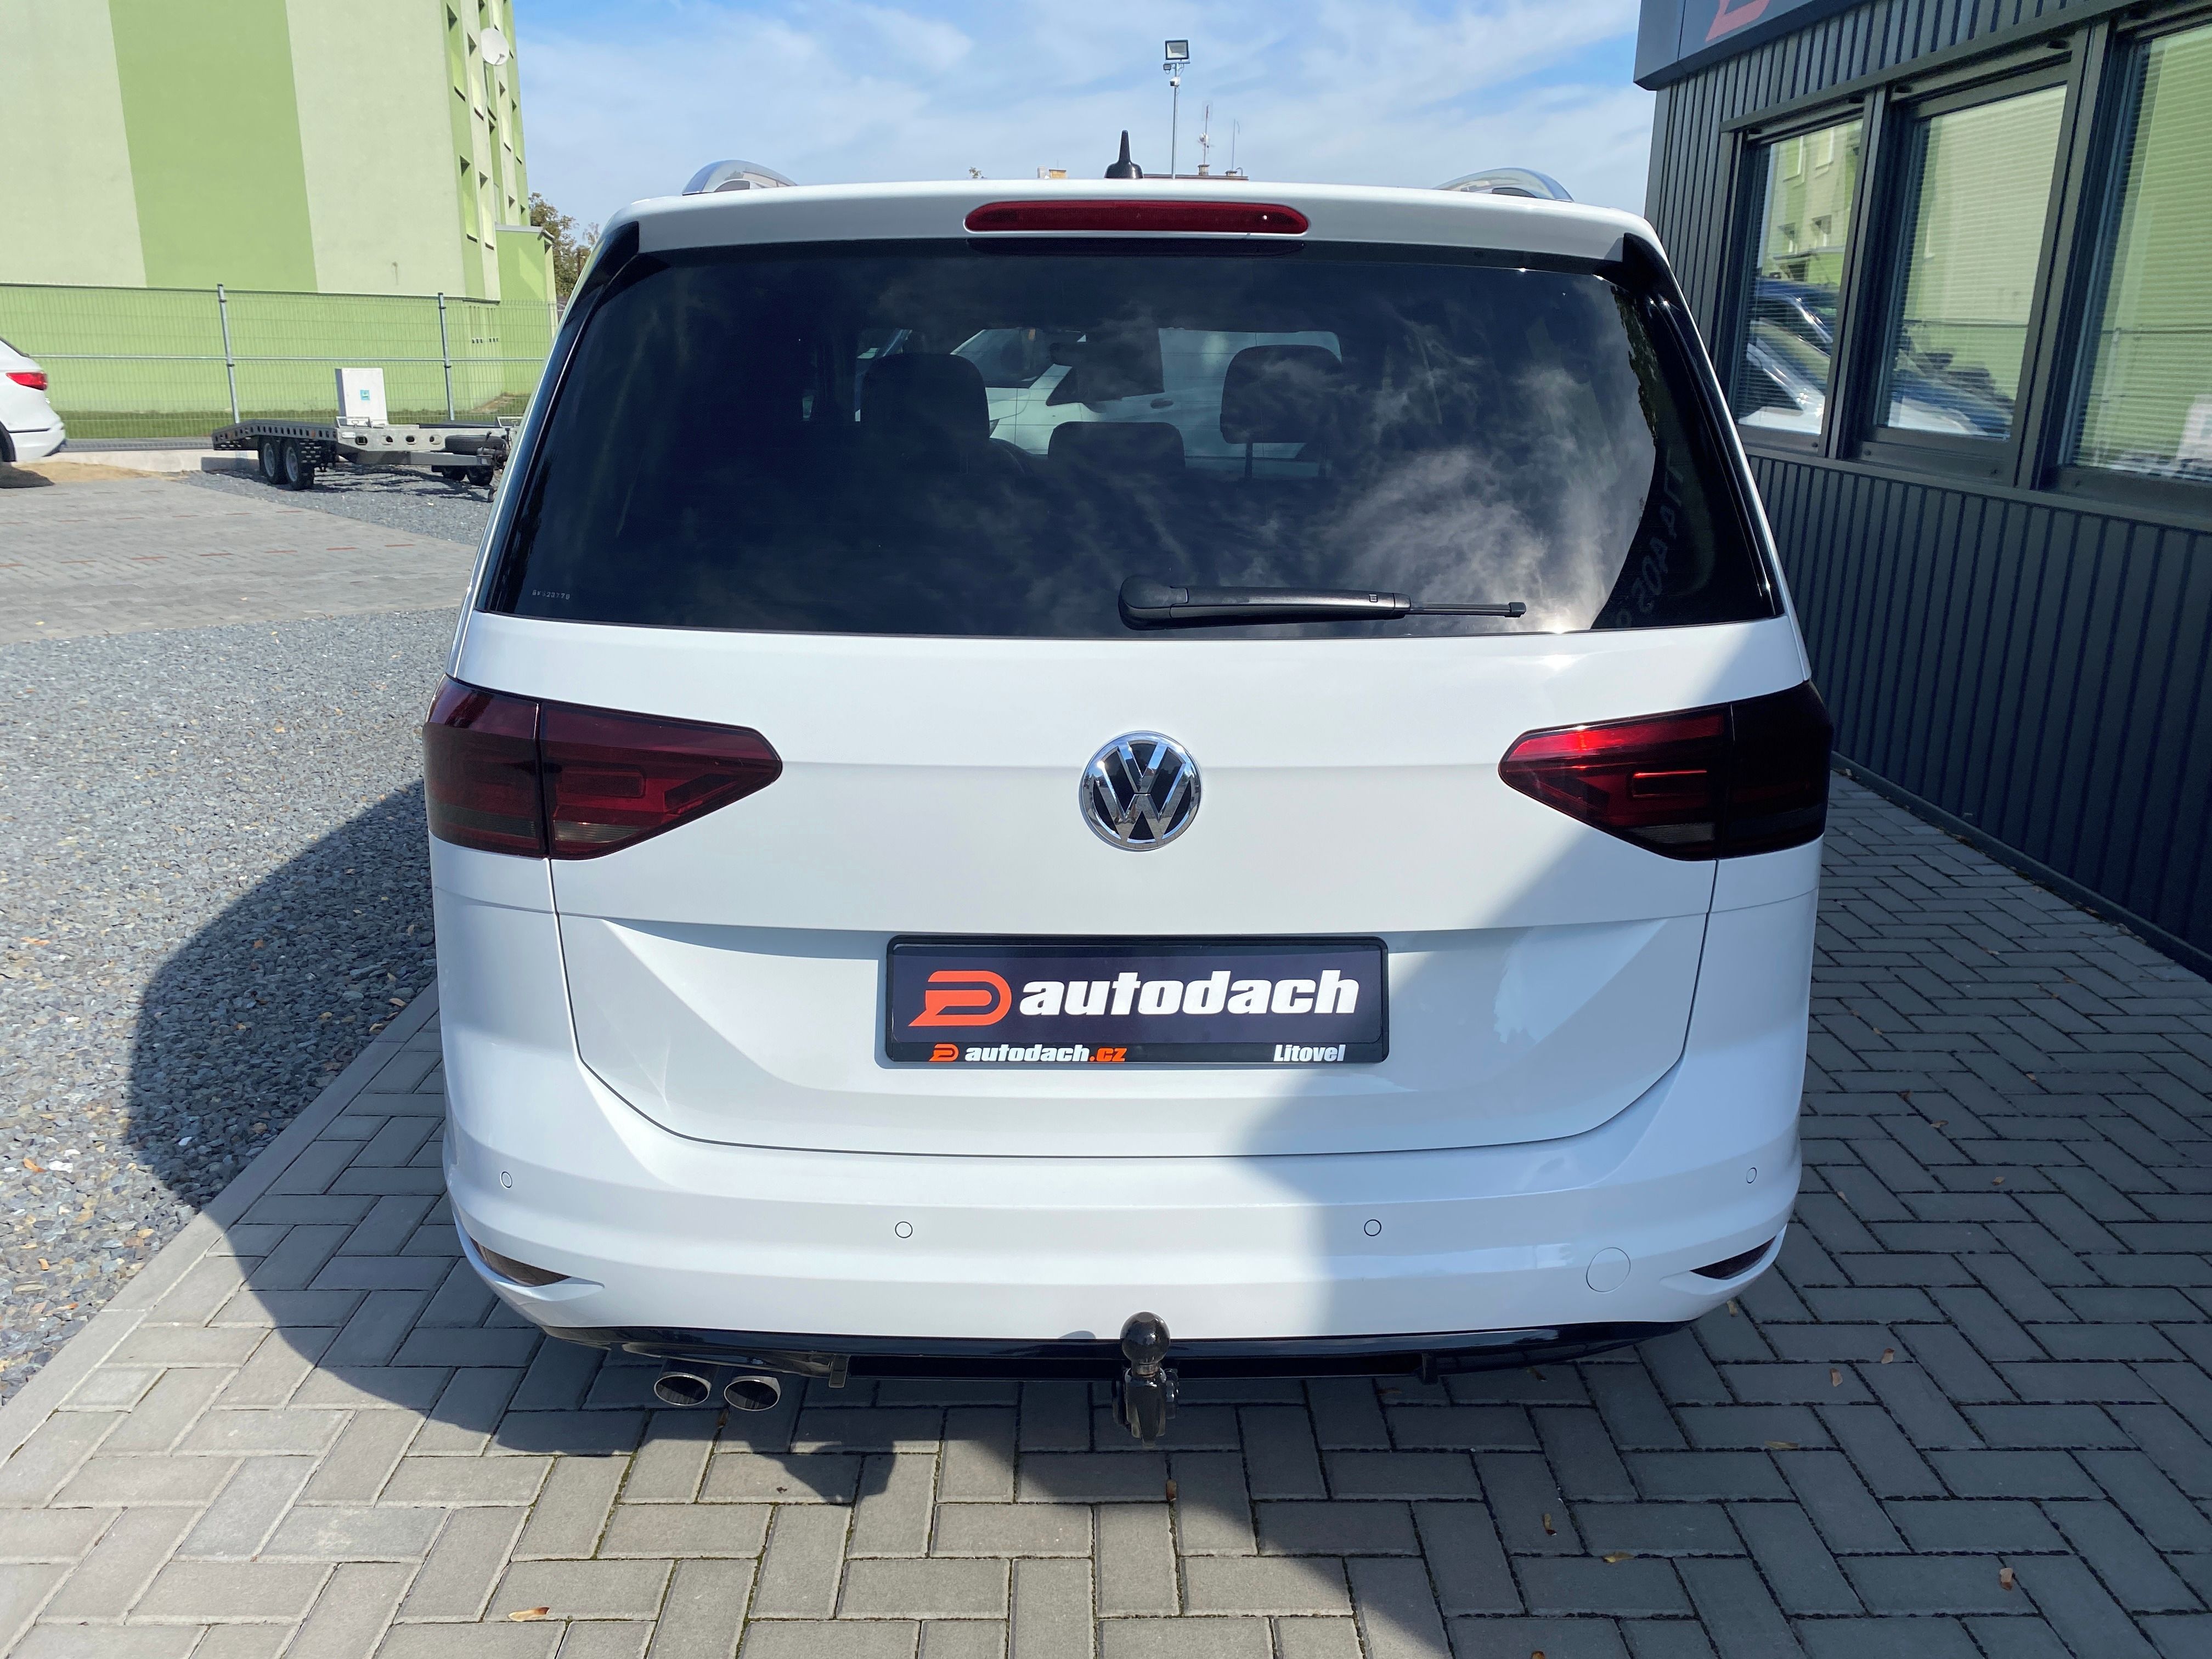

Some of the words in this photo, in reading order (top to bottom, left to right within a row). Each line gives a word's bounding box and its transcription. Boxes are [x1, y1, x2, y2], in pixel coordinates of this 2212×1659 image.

[1019, 969, 1359, 1015] autodach
[964, 1043, 1126, 1063] autodach.cz
[1273, 1043, 1345, 1063] Litovel
